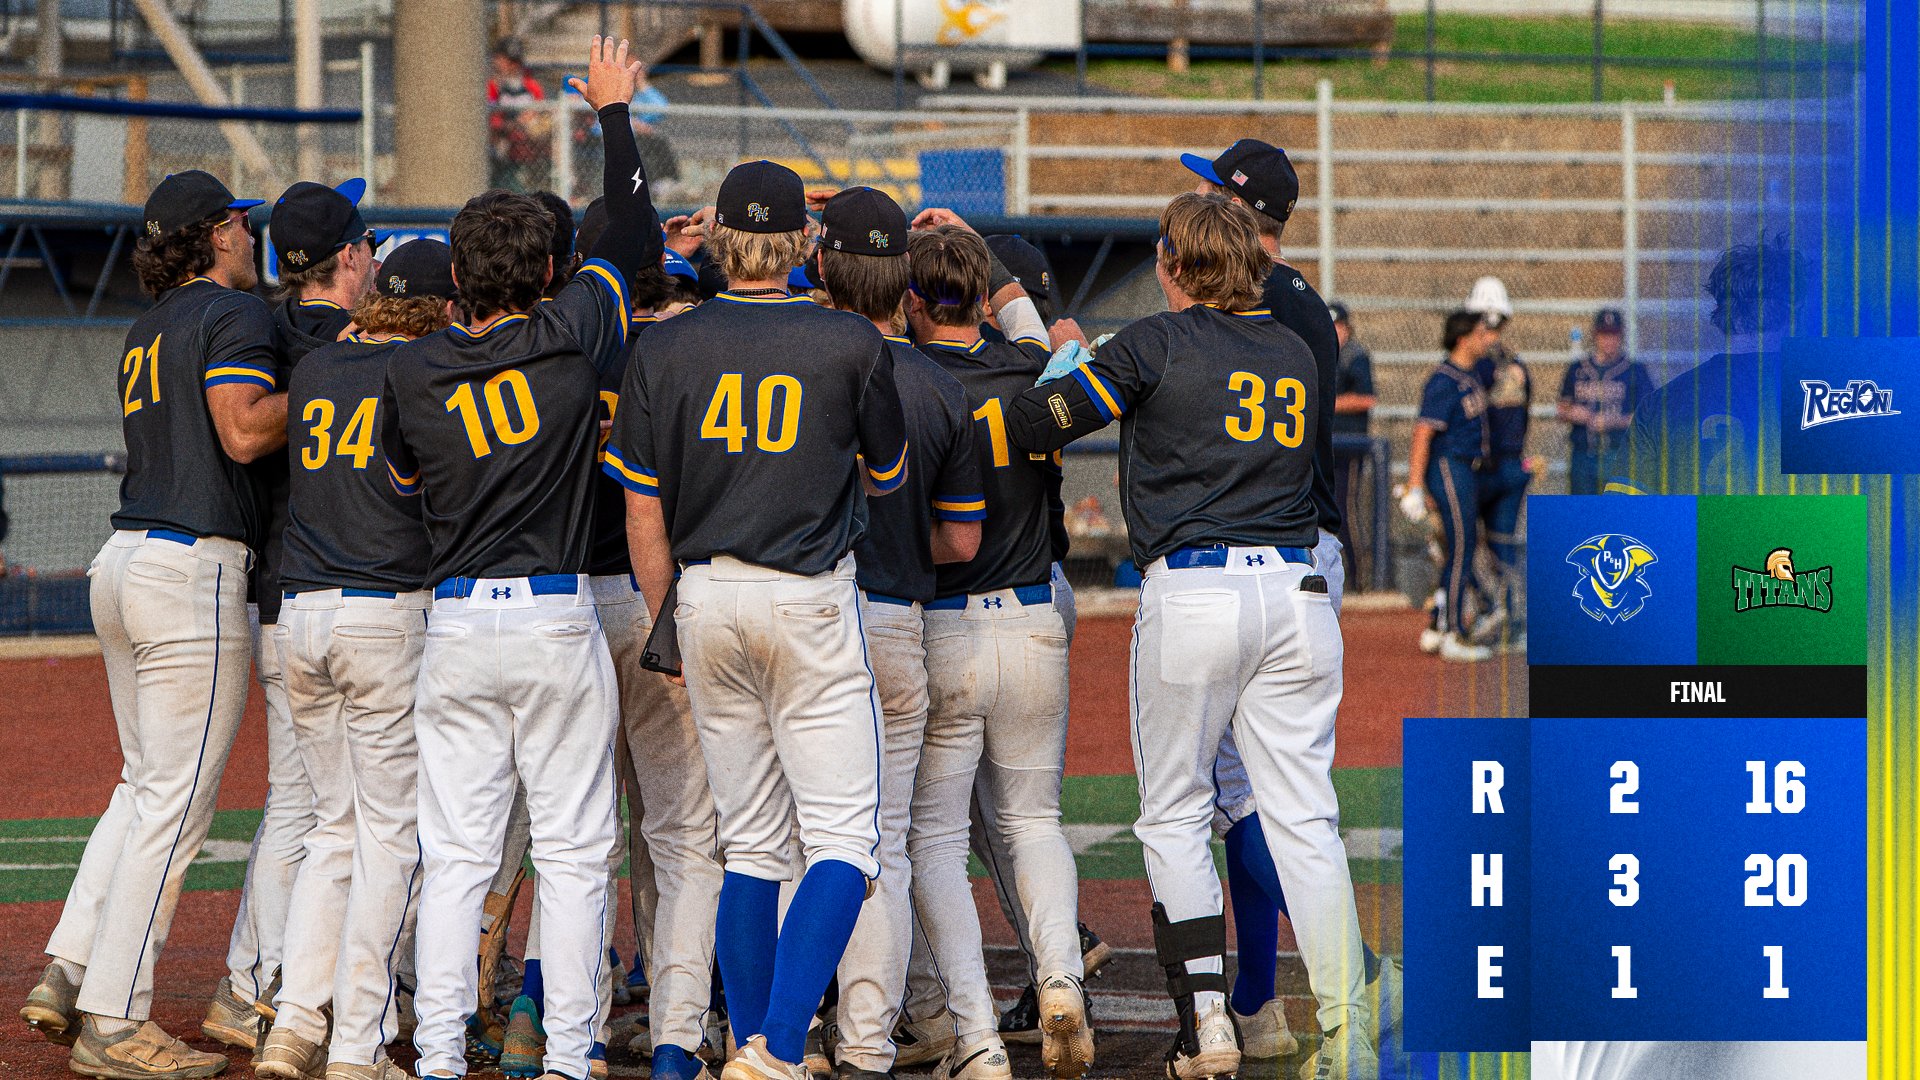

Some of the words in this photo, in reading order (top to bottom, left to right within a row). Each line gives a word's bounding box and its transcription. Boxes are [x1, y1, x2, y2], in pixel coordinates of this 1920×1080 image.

[123, 332, 162, 418] 21
[444, 368, 541, 459] 10
[700, 372, 804, 454] 40
[1224, 370, 1307, 449] 33
[300, 396, 380, 471] 34
